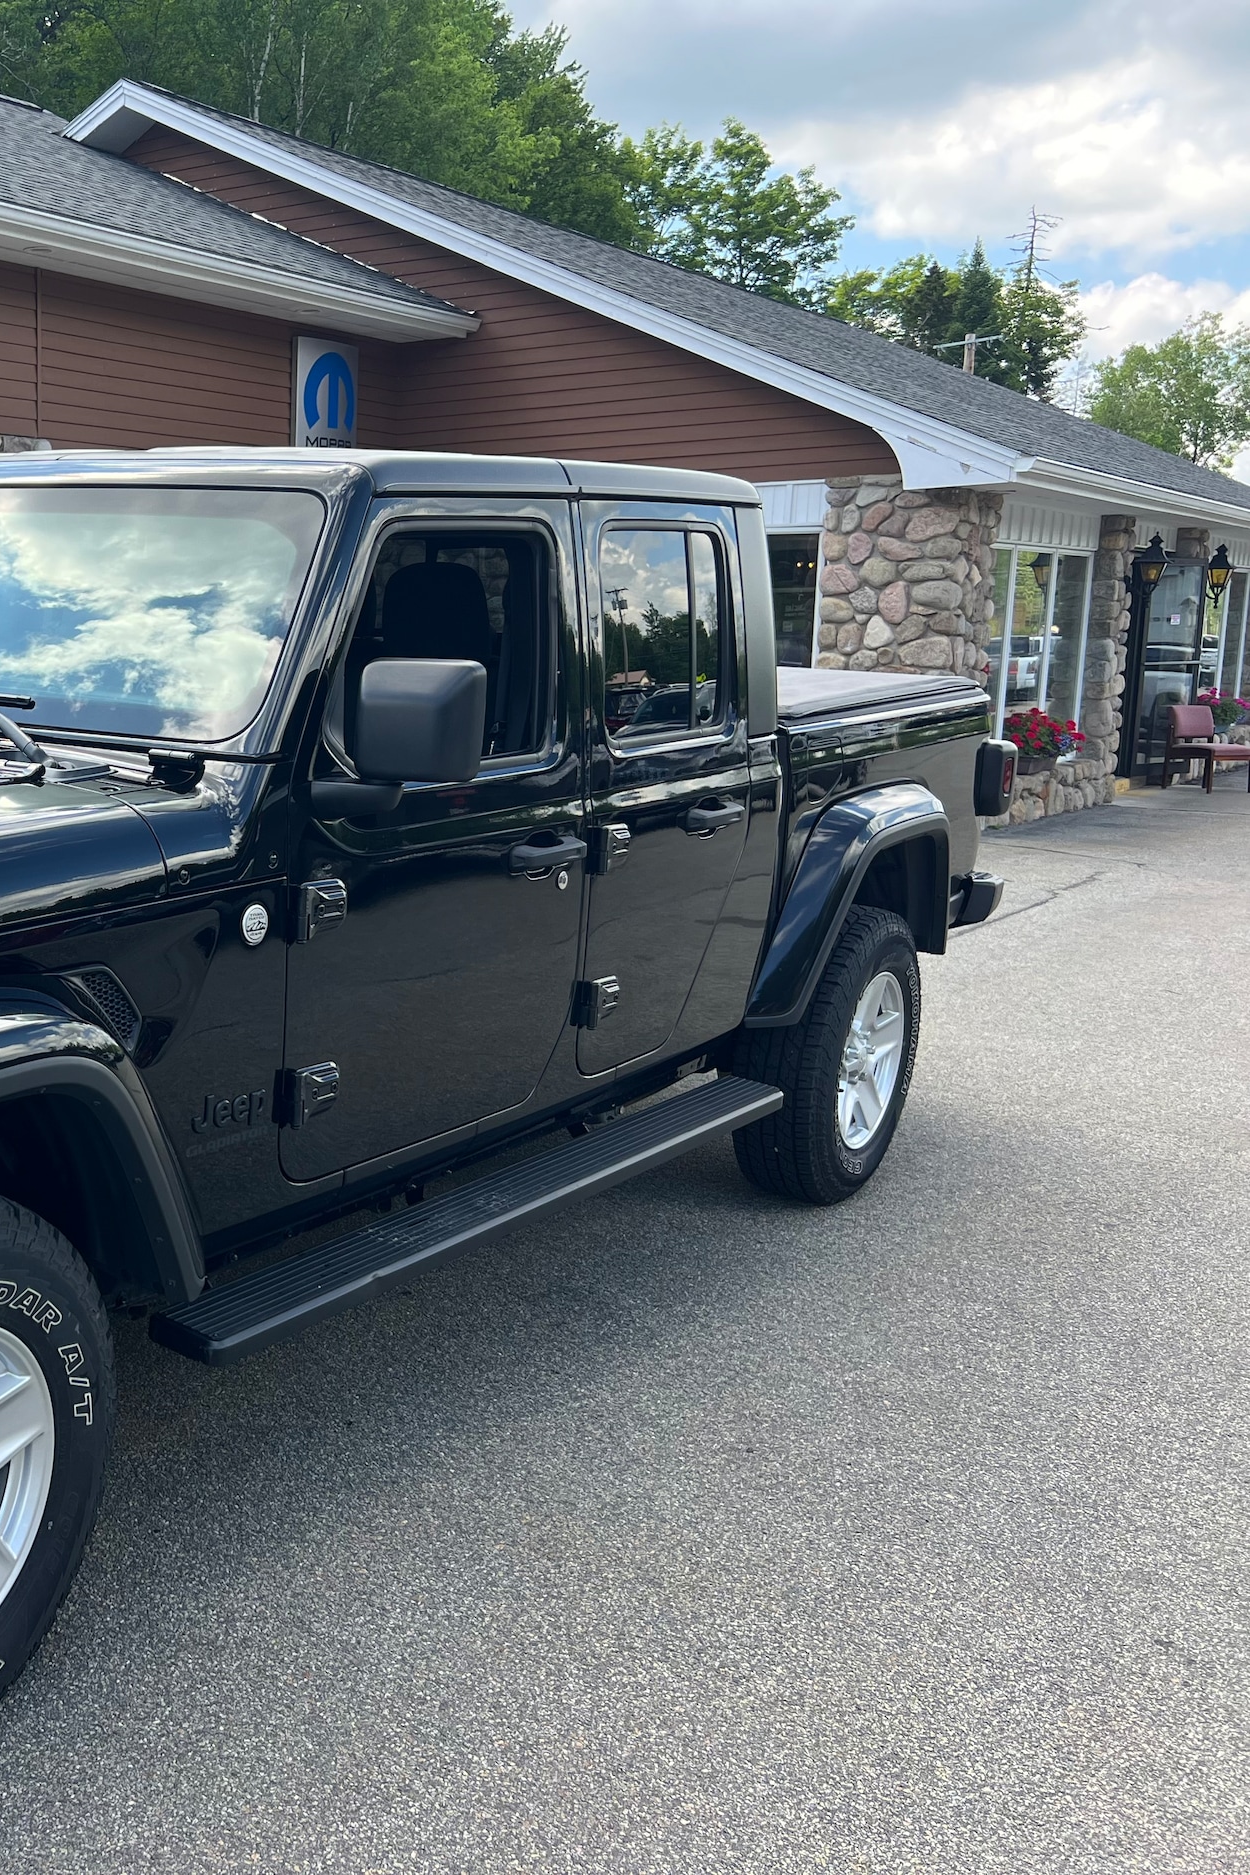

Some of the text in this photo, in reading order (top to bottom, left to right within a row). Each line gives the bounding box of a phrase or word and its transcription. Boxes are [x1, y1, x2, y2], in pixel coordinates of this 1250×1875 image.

[191, 1087, 267, 1135] Jeep
[185, 1125, 269, 1158] GLADIATOR
[57, 1343, 94, 1427] A/T
